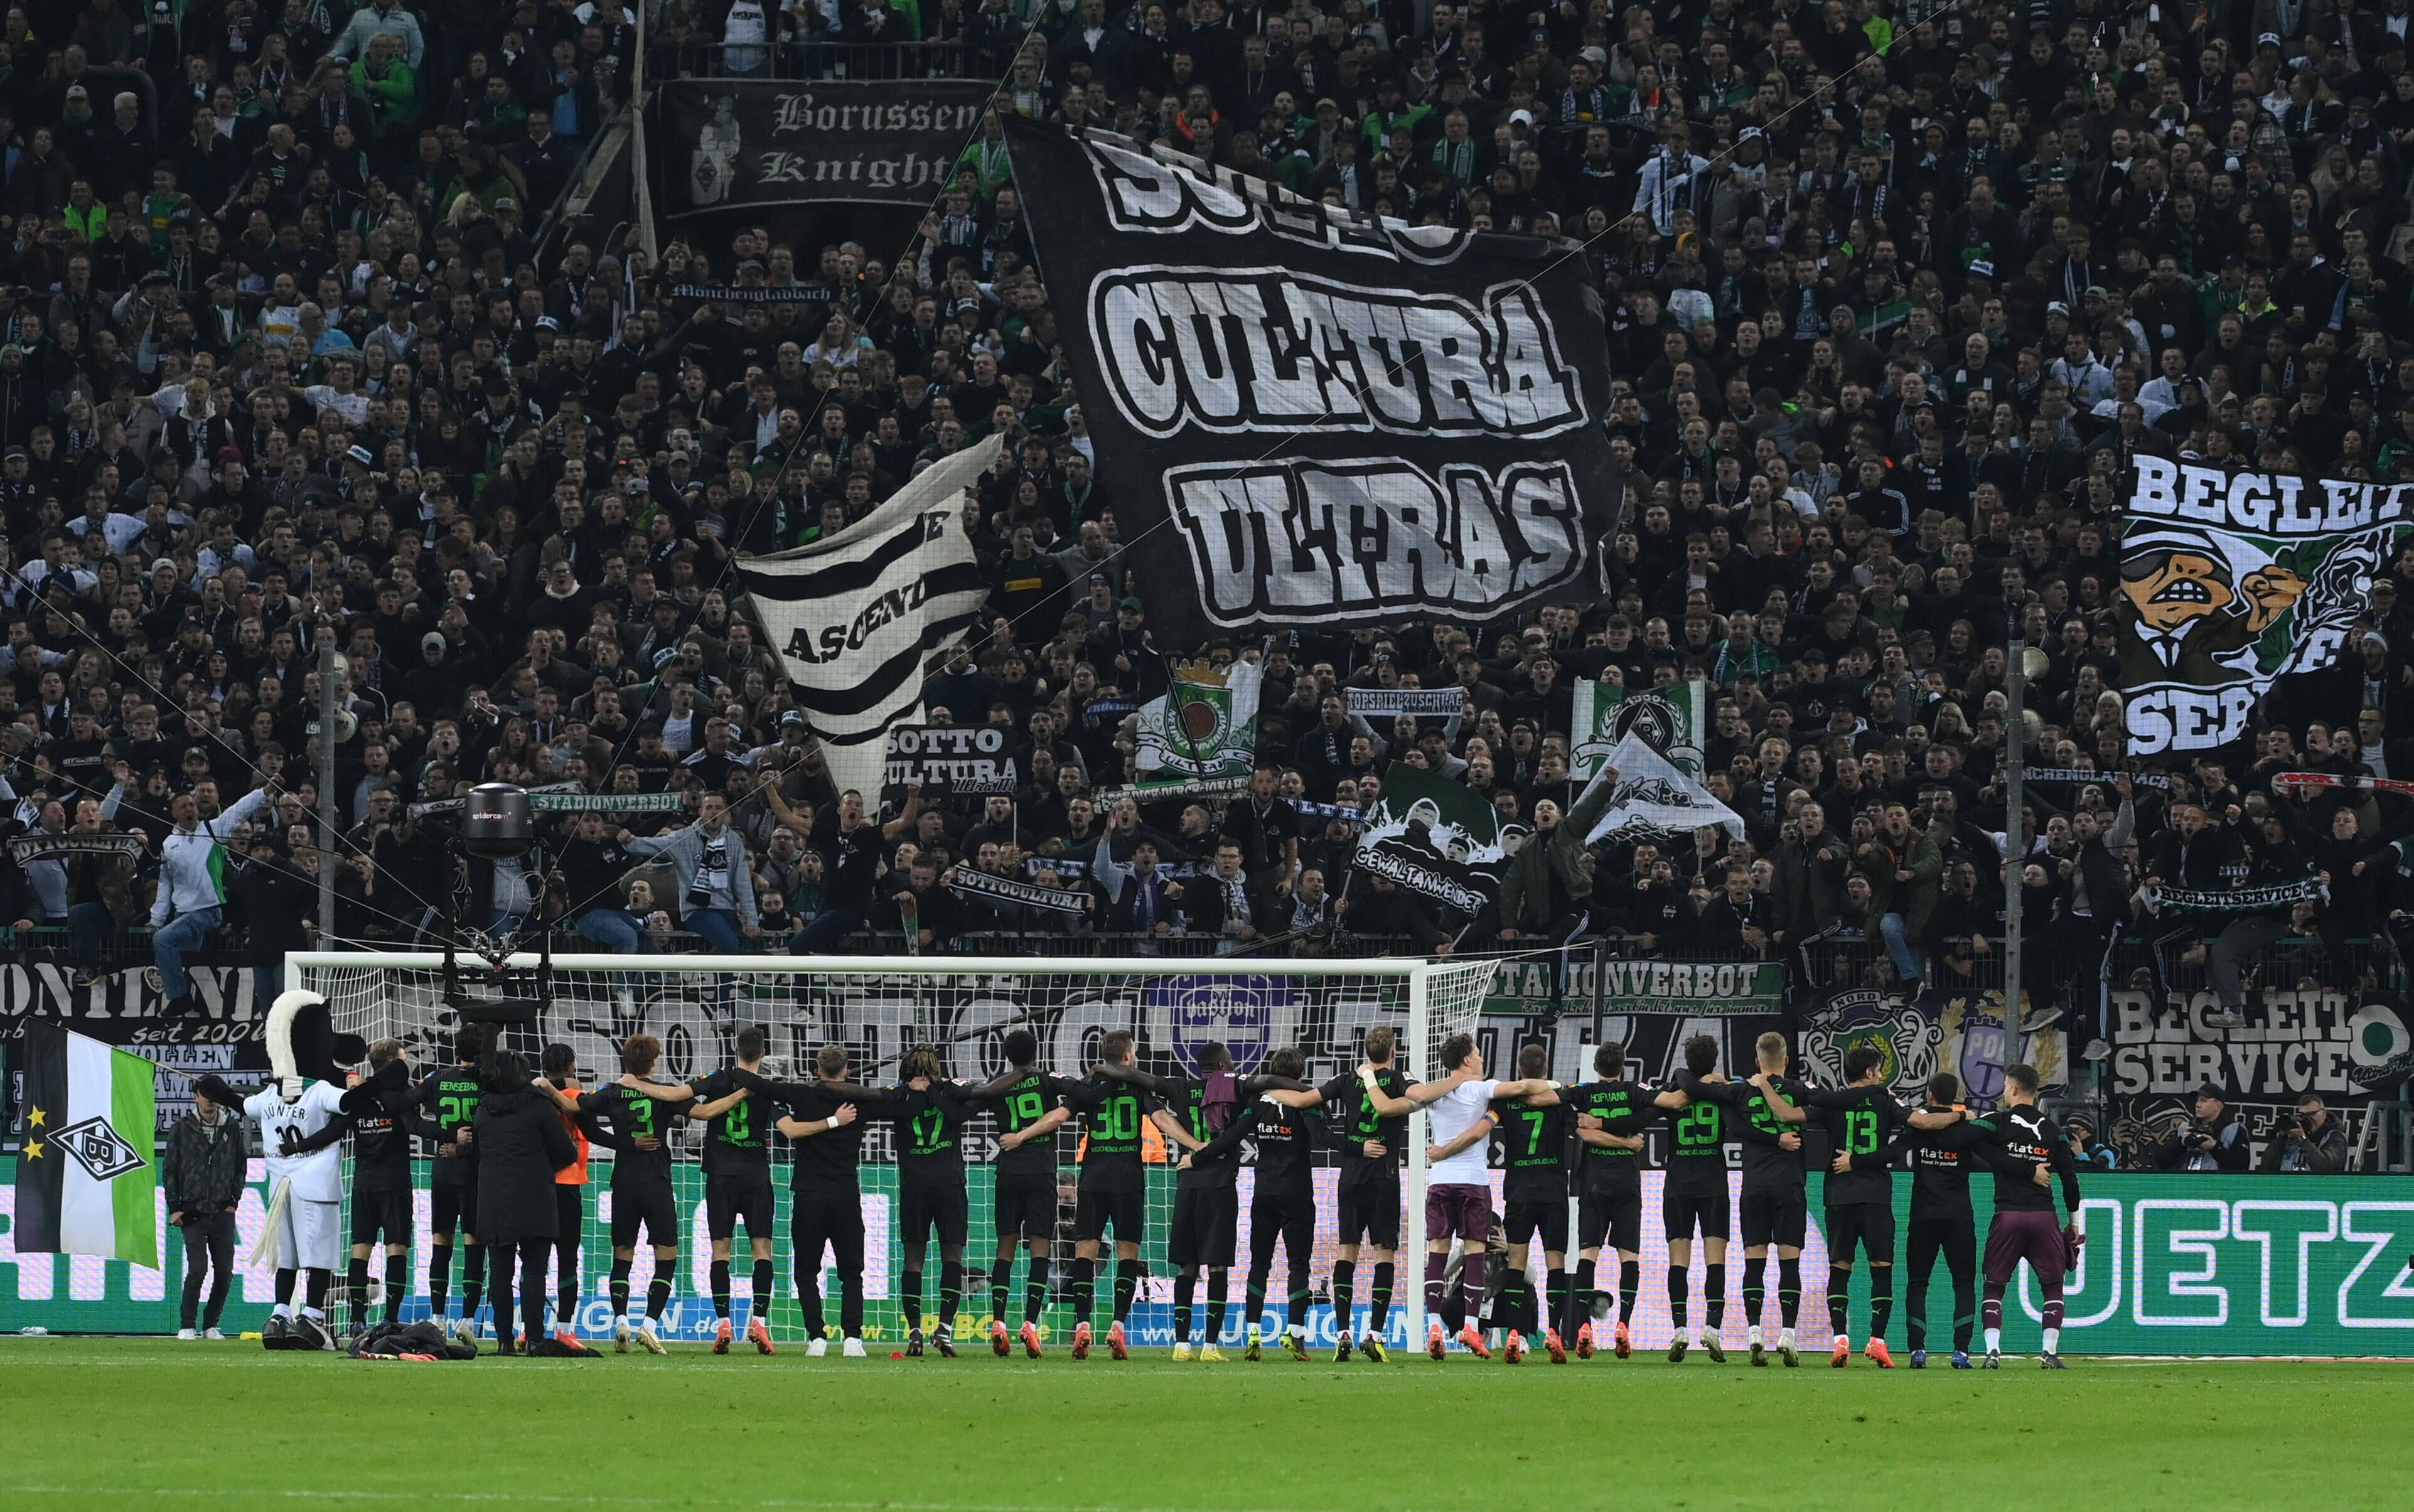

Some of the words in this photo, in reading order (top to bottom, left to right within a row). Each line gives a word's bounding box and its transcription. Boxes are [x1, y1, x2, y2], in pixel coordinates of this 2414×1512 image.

[773, 94, 978, 136] Borussen
[671, 285, 831, 301] Mönchengladbach
[1095, 273, 1579, 433] CULTURA
[1174, 468, 1579, 615] ULTRAS
[537, 793, 684, 812] STADIONVERBOT
[957, 871, 1083, 910] SOTTOCULTURA
[2159, 884, 2302, 908] BEGLEITSERVICE
[1835, 993, 1880, 1006] NORD
[2110, 990, 2354, 1044] BEGLEIT
[131, 1023, 183, 1043] seit
[2113, 1042, 2350, 1095] SERVICE
[264, 1104, 306, 1119] JÜNTER
[1004, 1091, 1045, 1132] 19
[1087, 1095, 1139, 1141] 30
[1589, 1091, 1629, 1104] HOFMANN
[357, 1117, 393, 1129] flatex
[628, 1098, 655, 1139] 3
[724, 1098, 749, 1141] 8
[910, 1105, 945, 1147] 17
[1257, 1122, 1293, 1135] flatex
[1521, 1111, 1545, 1155] 7
[1676, 1100, 1720, 1146] 29
[1845, 1110, 1878, 1155] 13
[1919, 1148, 1958, 1161] flatex
[2006, 1142, 2049, 1156] flatex
